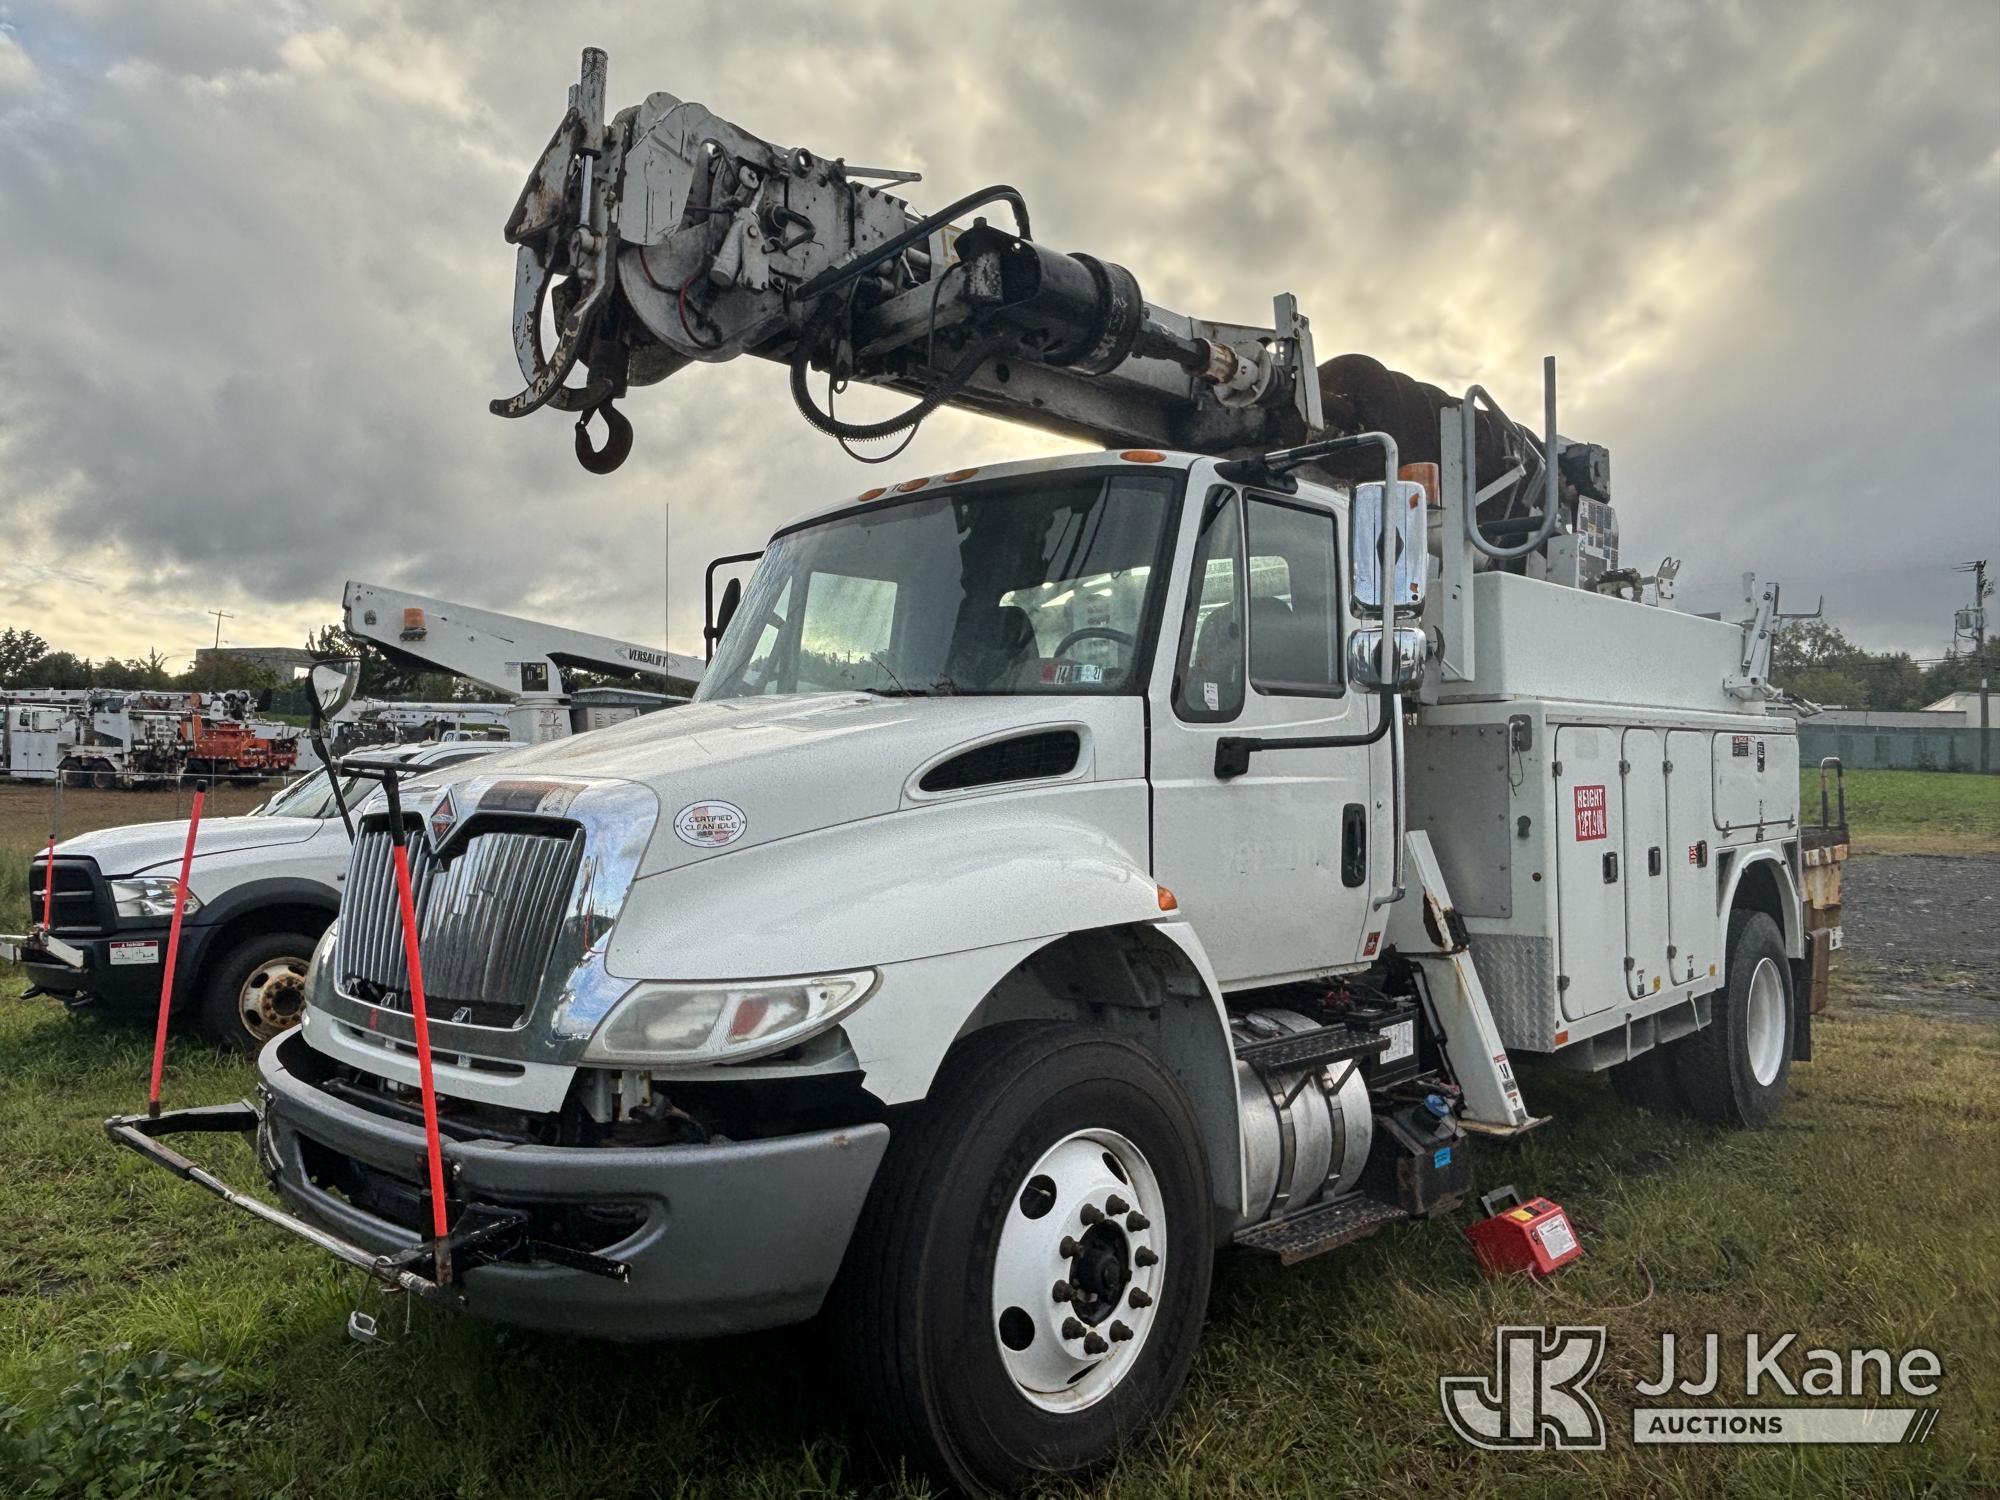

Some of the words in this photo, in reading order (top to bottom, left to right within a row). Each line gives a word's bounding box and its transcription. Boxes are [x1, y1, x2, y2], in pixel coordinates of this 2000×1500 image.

[629, 648, 668, 667] VERSALIFT
[1577, 788, 1603, 808] HEIGHT
[689, 815, 732, 823] CERTIFIED
[684, 823, 715, 831] CLEAN
